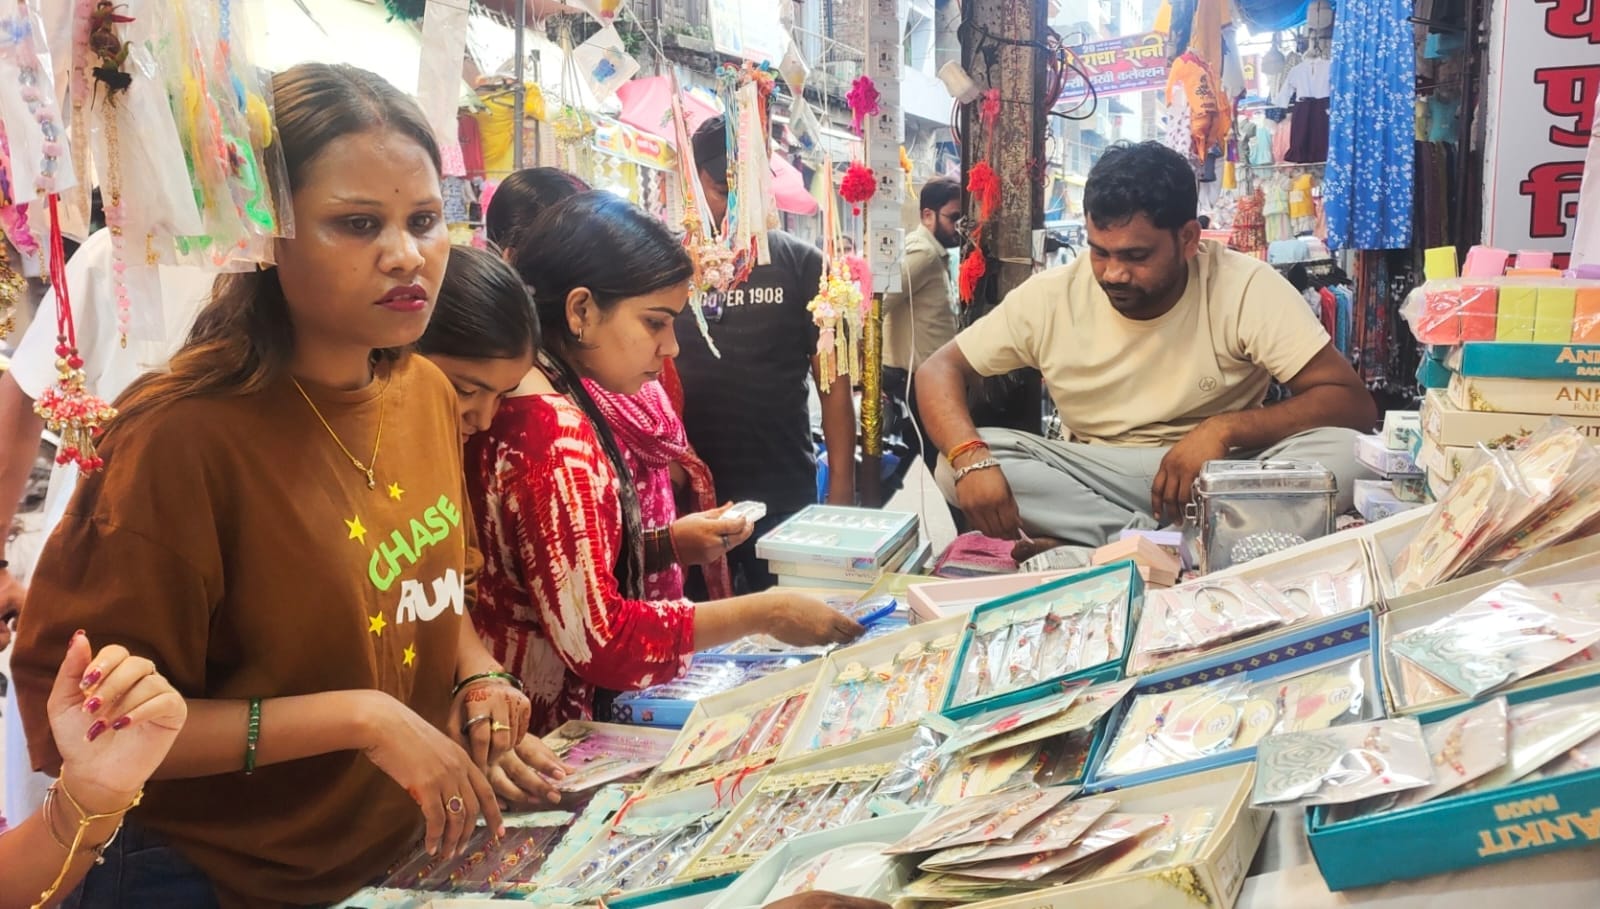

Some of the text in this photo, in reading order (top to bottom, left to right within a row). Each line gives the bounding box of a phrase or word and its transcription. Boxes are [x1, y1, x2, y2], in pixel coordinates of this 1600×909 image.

[748, 286, 784, 305] 1908
[369, 494, 461, 592] CHASE
[396, 568, 465, 624] RUN
[1477, 808, 1600, 858] ANKIT
